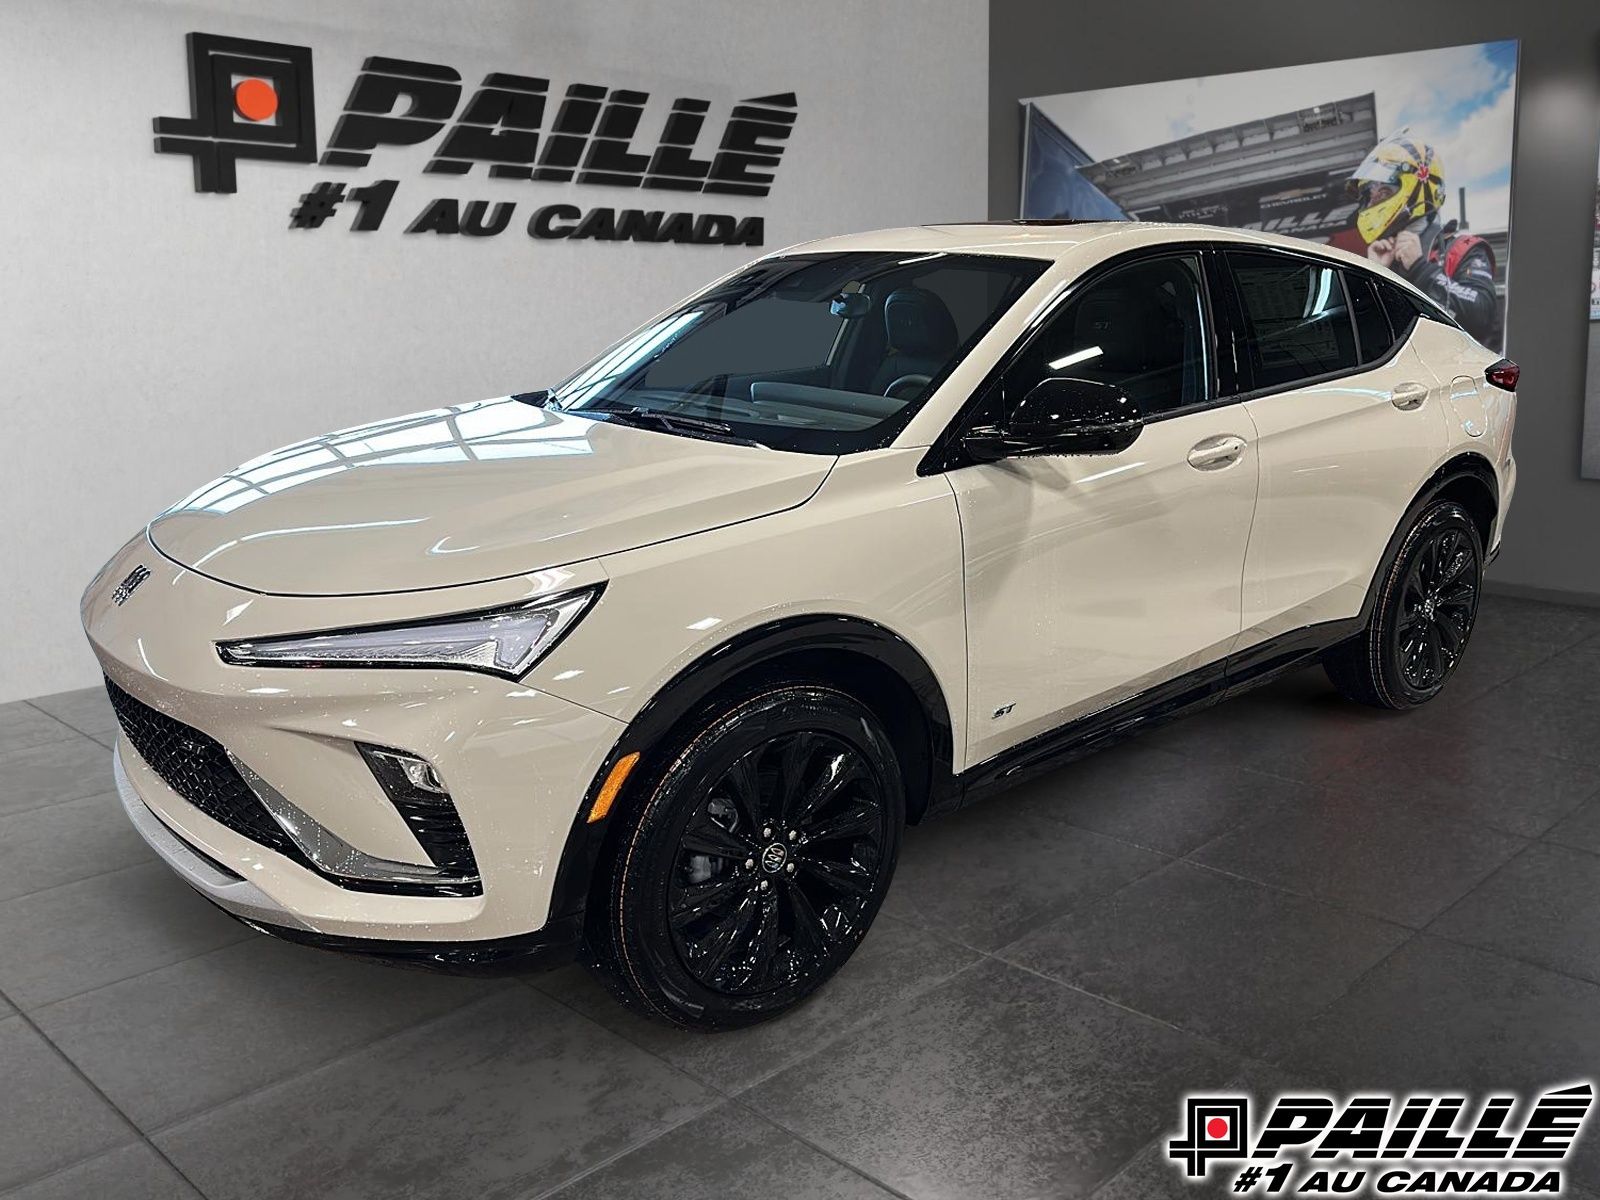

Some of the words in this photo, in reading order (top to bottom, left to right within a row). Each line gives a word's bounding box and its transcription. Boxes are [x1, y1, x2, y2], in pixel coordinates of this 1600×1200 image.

[318, 56, 798, 197] PAILLÉ
[288, 179, 400, 232] #1
[402, 198, 517, 237] AU
[526, 203, 764, 246] CANADA
